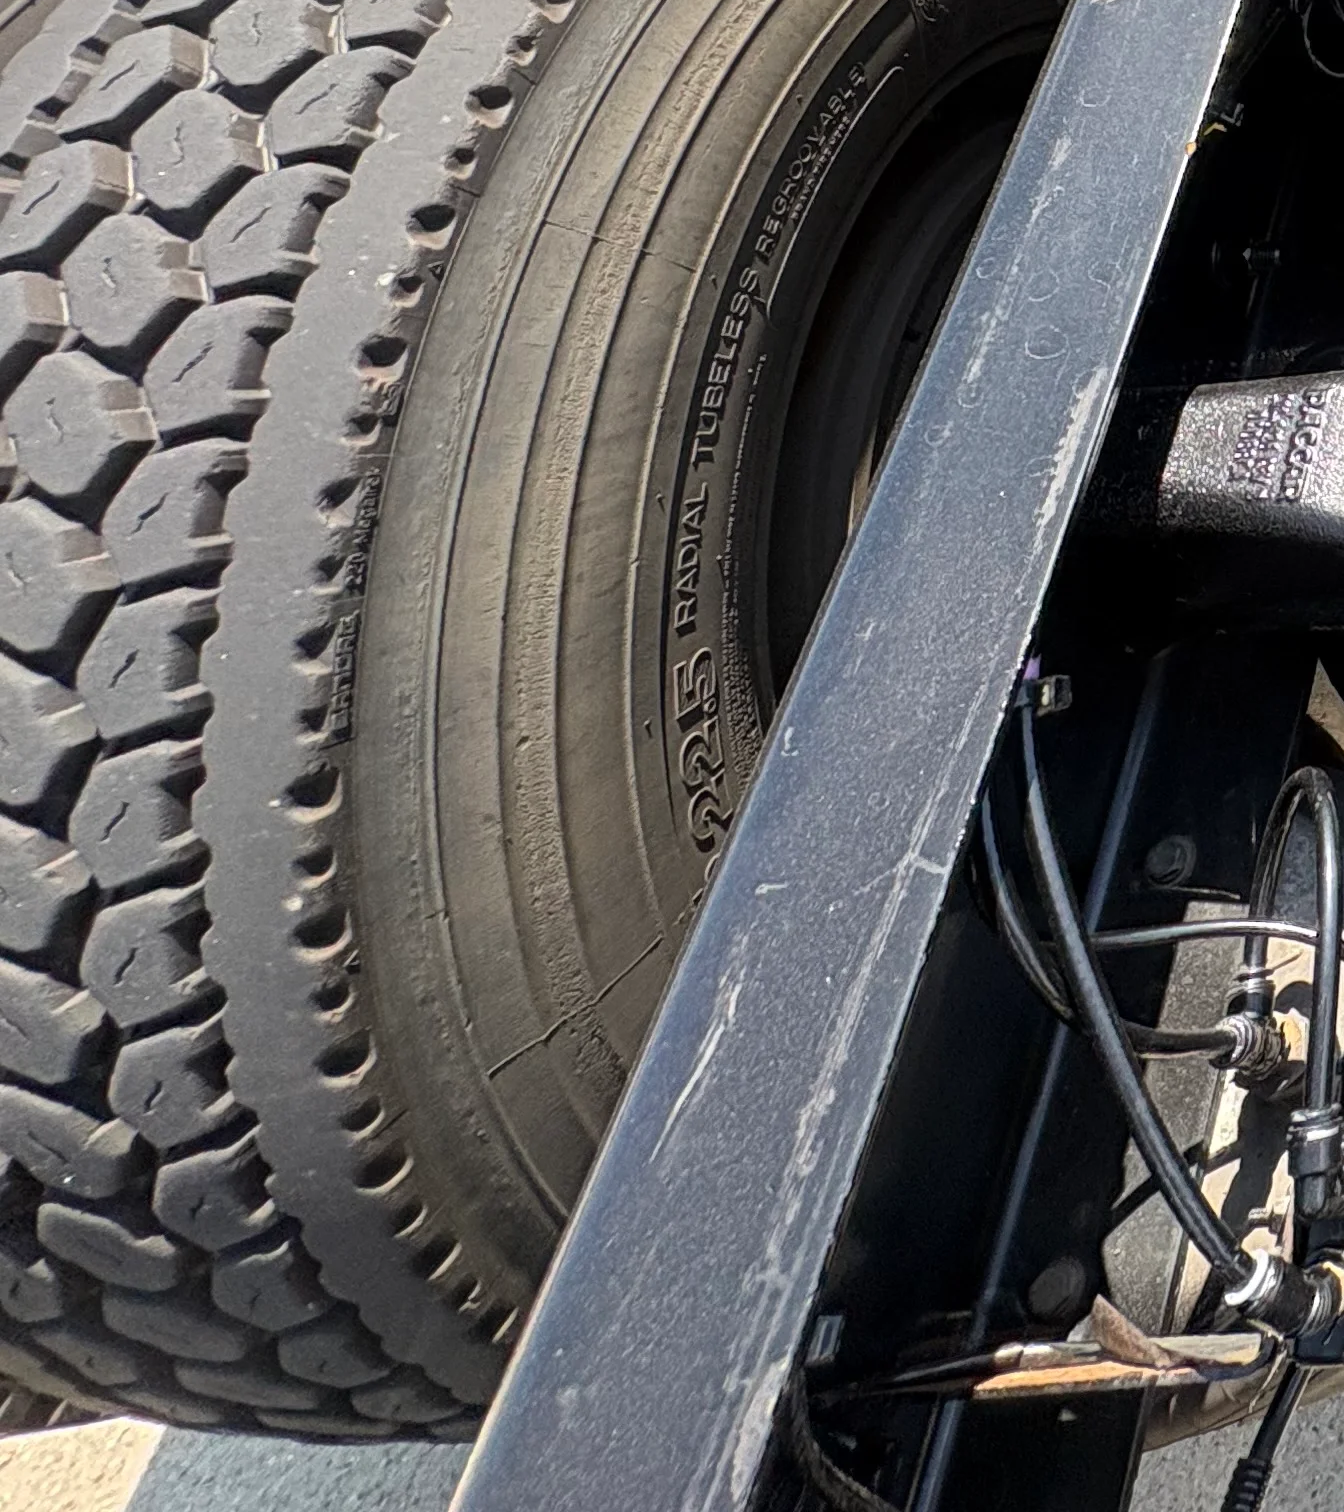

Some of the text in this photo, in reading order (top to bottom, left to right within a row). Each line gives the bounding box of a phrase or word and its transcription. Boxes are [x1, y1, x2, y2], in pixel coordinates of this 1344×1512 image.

[755, 61, 866, 254] REGROOVABLE
[690, 266, 758, 466] TUBELESS
[1280, 390, 1325, 502] PACCAR
[673, 482, 709, 630] RADIAL
